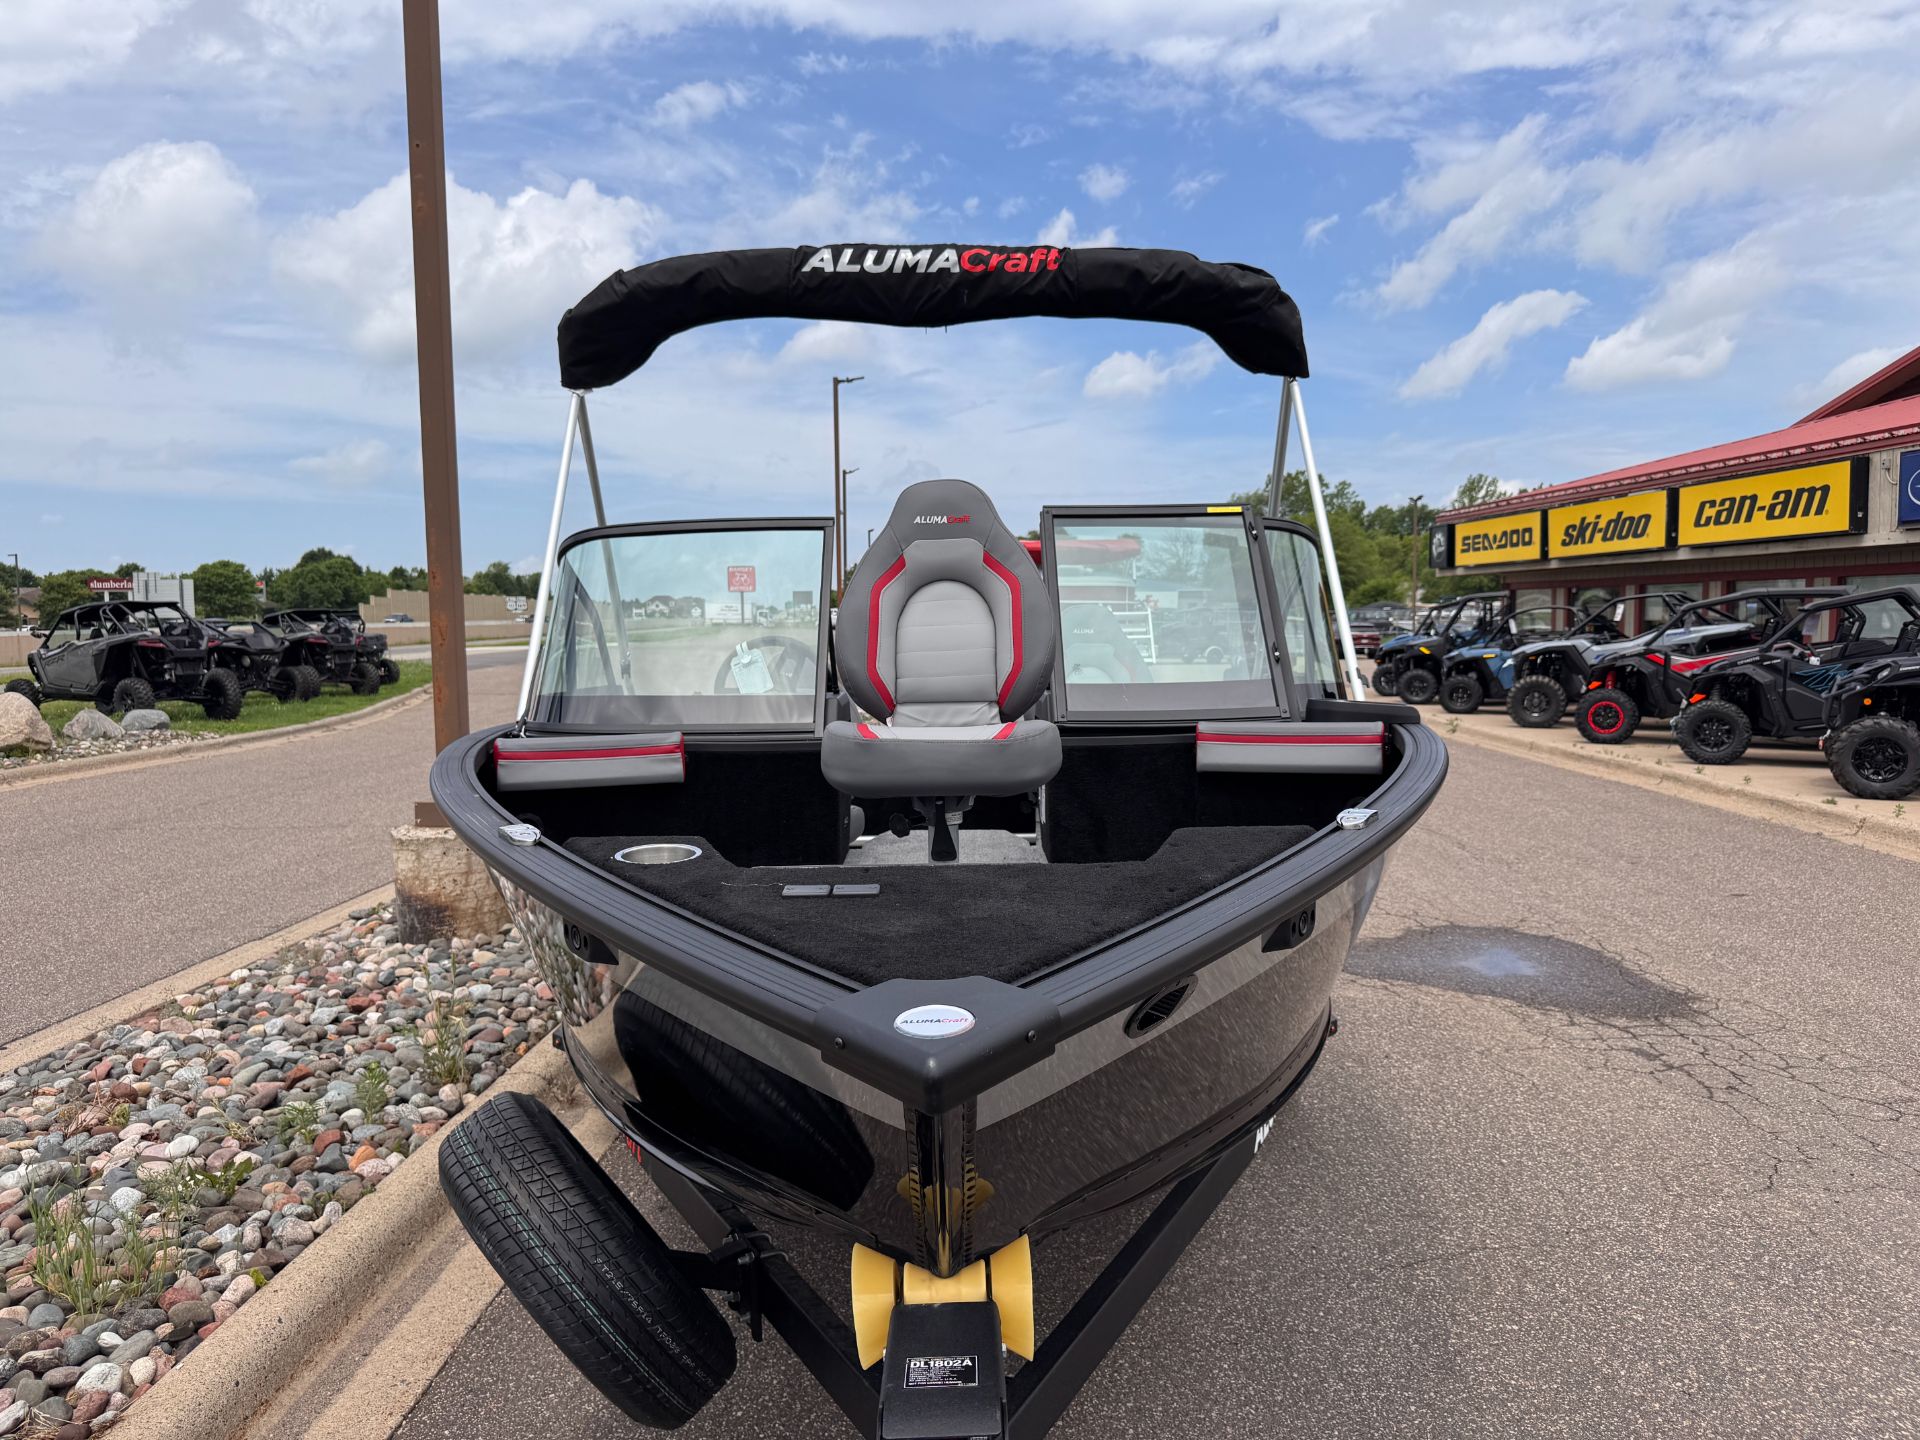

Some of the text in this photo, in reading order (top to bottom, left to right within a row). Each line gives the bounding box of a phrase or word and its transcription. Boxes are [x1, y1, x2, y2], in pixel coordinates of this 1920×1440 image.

[801, 248, 1061, 273] ALUMACraft
[1693, 484, 1831, 528] can-am
[1560, 511, 1652, 547] ski-doo
[90, 580, 134, 589] slumberla
[910, 1359, 973, 1368] DL1802A
